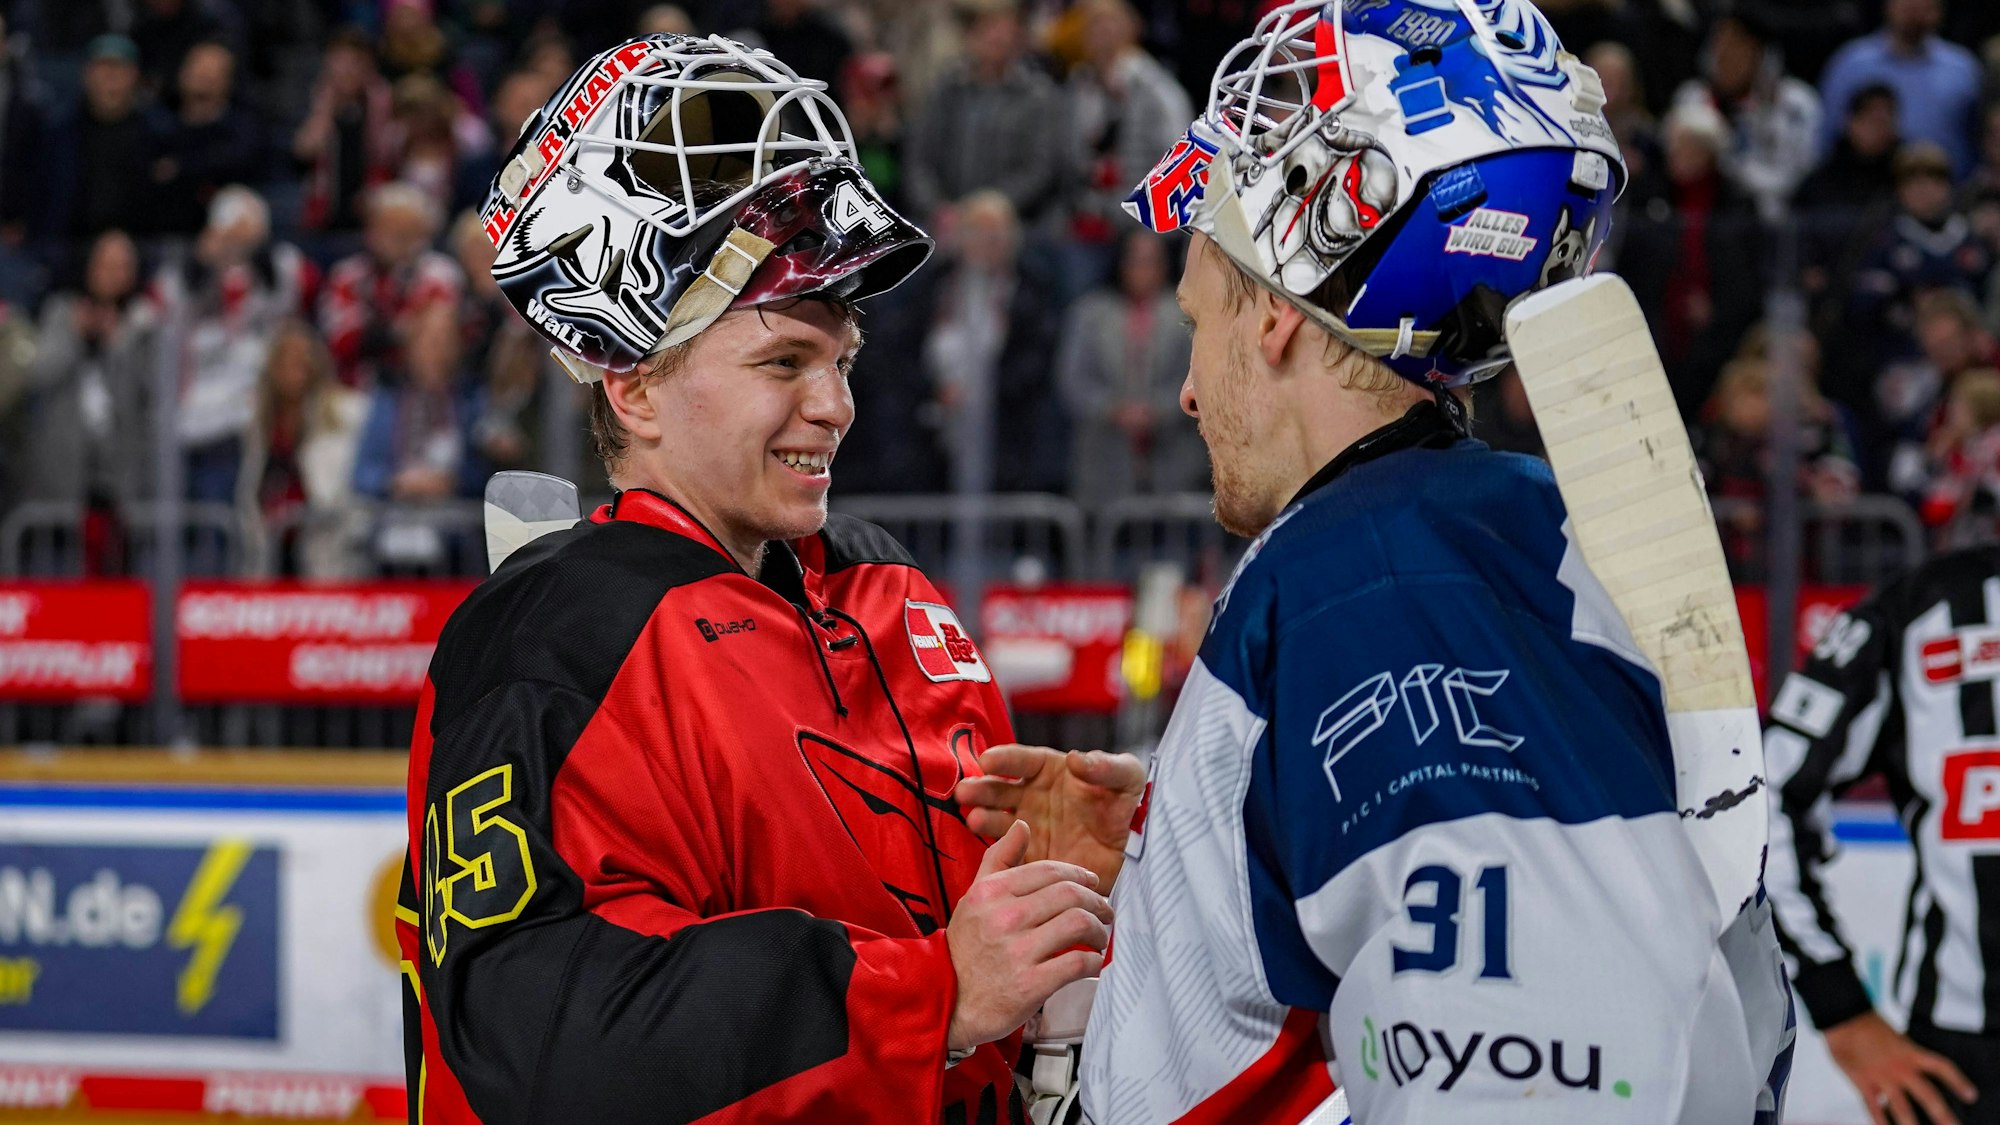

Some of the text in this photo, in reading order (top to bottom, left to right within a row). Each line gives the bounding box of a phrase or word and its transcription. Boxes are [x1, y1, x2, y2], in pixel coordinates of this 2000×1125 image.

[832, 180, 895, 235] 4
[1470, 212, 1525, 235] ALLES
[1450, 231, 1531, 257] WIRD GUT
[1387, 762, 1457, 796] CAPITAL
[426, 763, 538, 969] 45
[1390, 862, 1520, 986] 31
